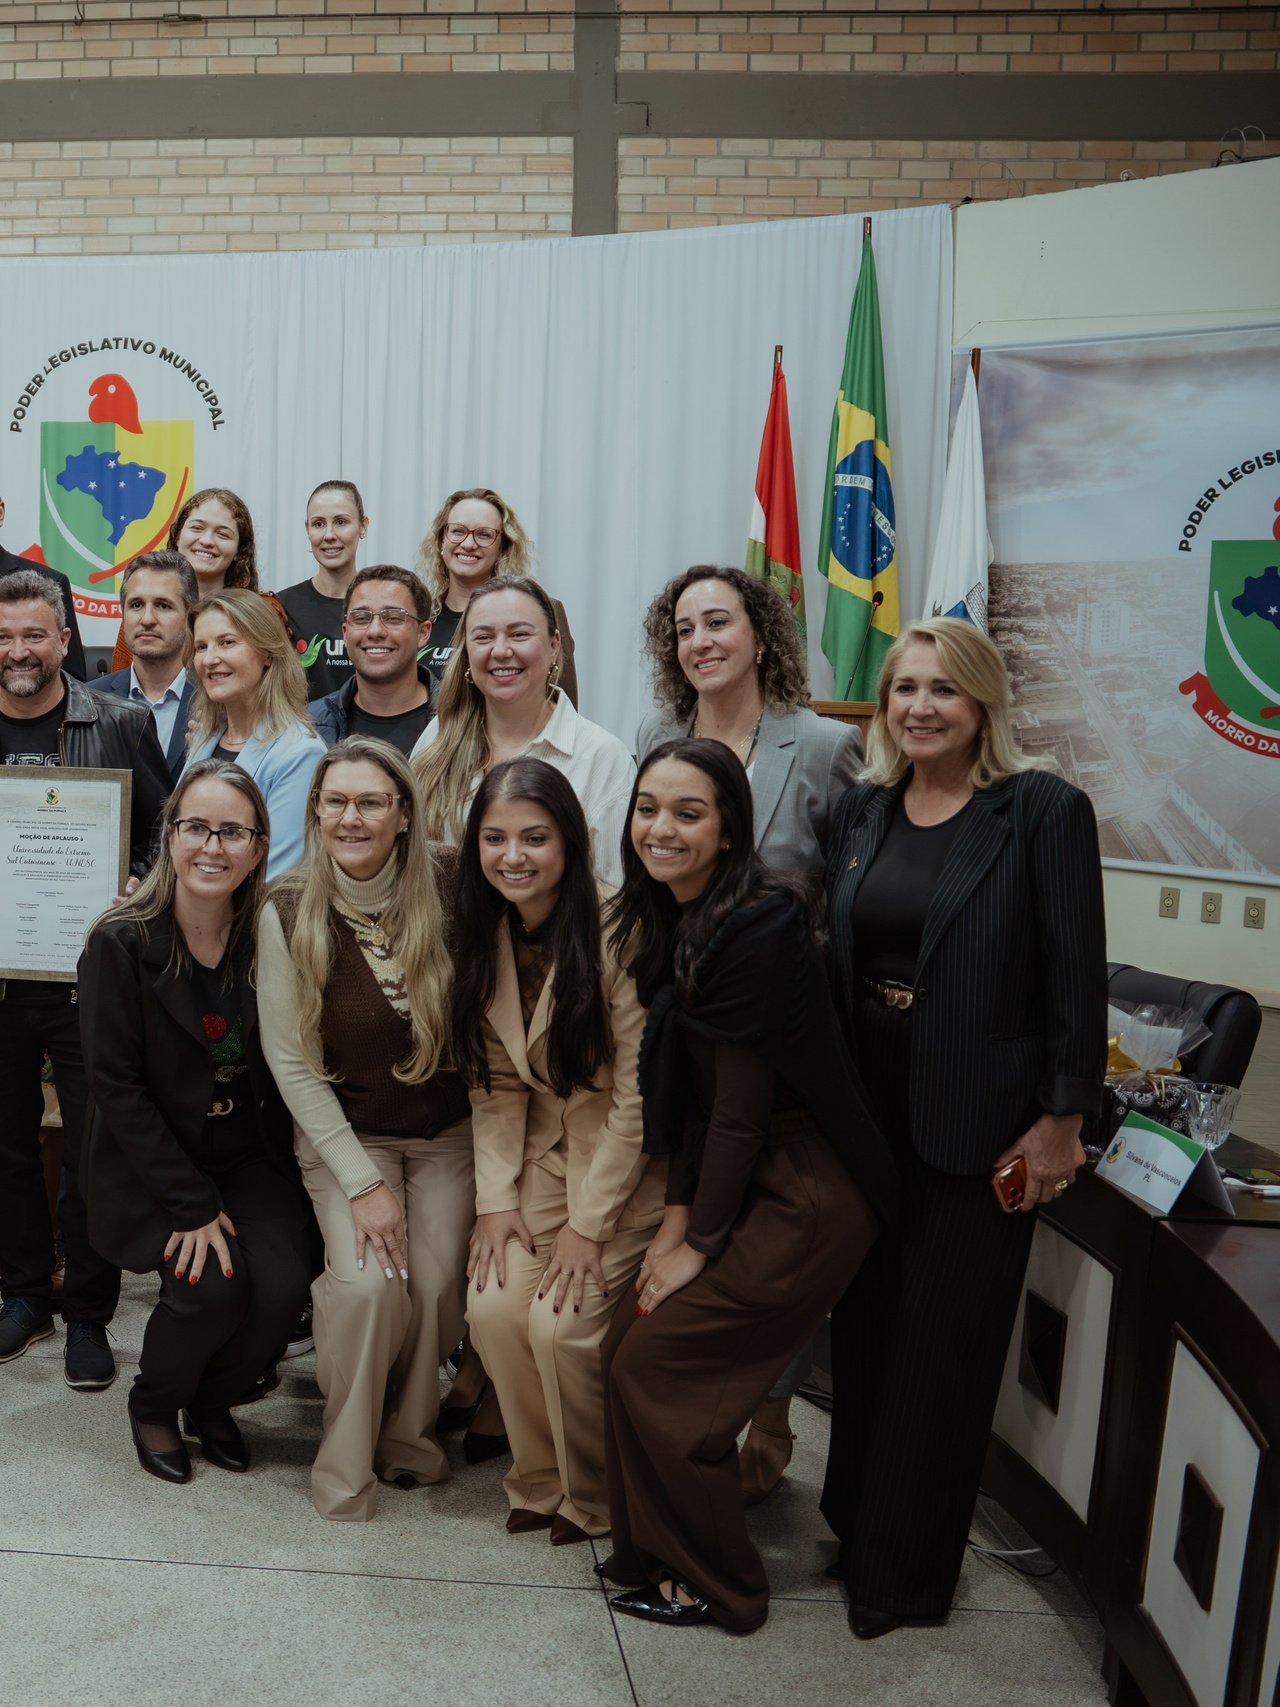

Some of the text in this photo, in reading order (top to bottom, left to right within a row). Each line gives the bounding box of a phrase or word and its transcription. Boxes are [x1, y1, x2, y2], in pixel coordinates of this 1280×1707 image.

[9, 337, 225, 433] PODER LEGISLATIVO MUNICIPAL
[1178, 487, 1221, 552] PODER
[88, 601, 108, 614] DA
[1204, 709, 1280, 754] MORRO DA
[6, 856, 18, 864] Sul
[19, 856, 56, 866] Catarinense
[66, 858, 97, 867] UNESC
[12, 844, 91, 856] Universidade do Extremo
[1126, 1151, 1144, 1166] Silvana
[1151, 1164, 1181, 1186] Vasconcelos
[1143, 1173, 1151, 1182] PL
